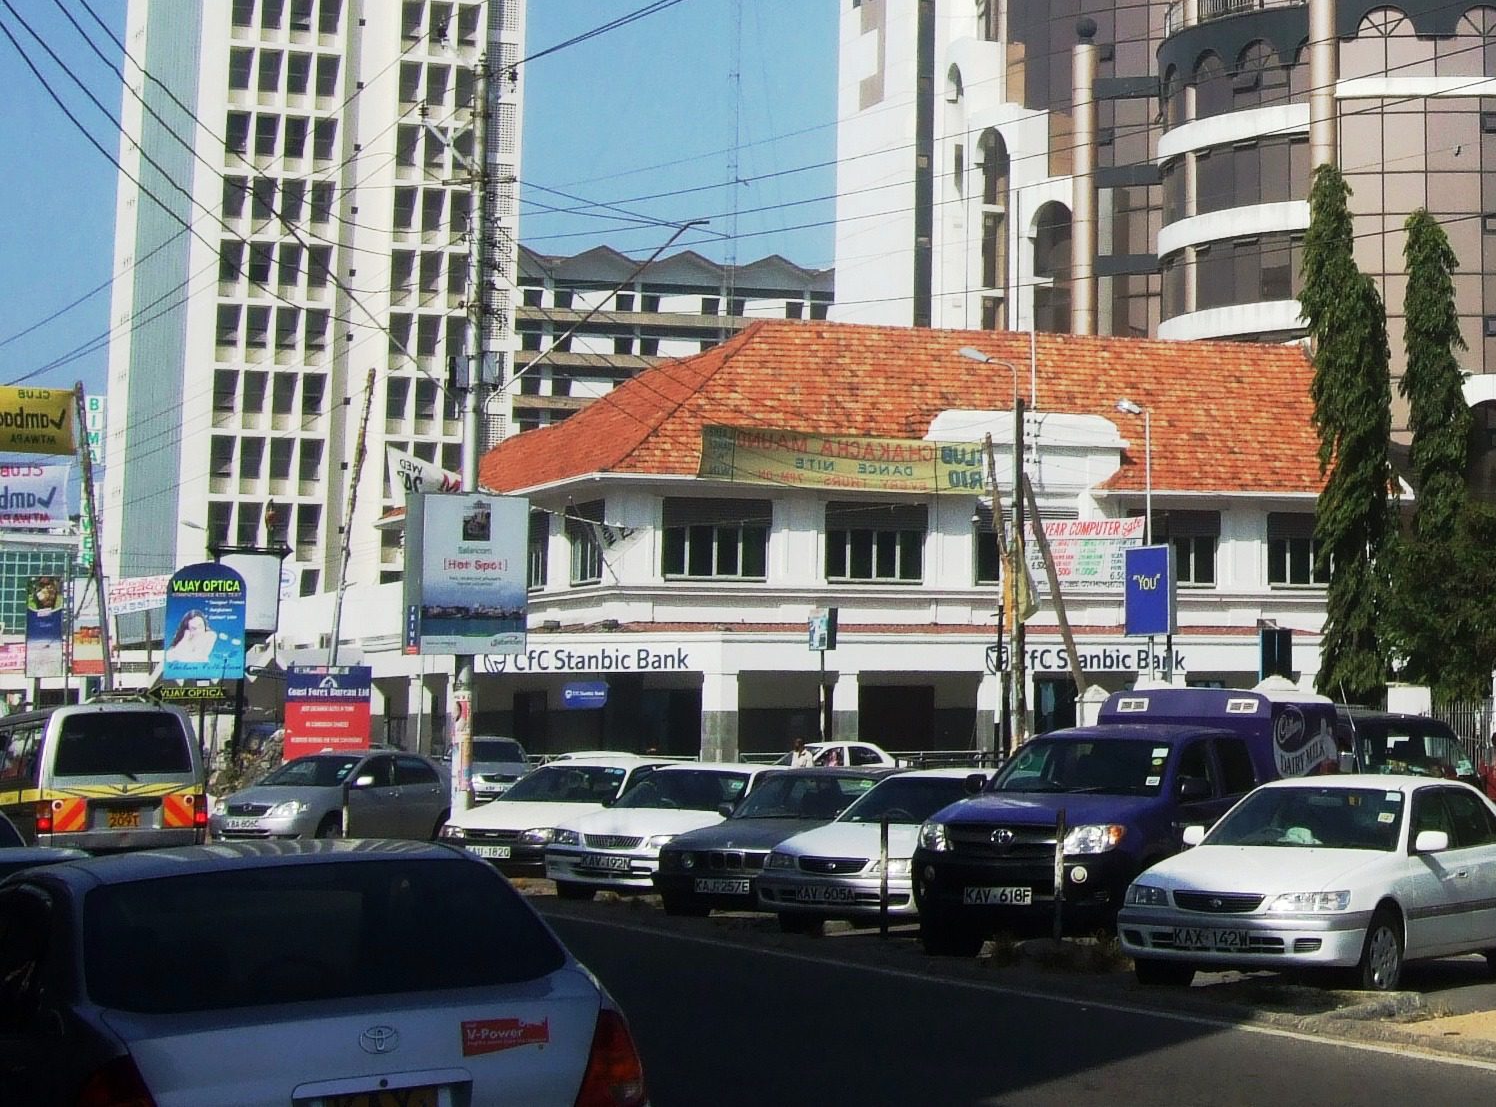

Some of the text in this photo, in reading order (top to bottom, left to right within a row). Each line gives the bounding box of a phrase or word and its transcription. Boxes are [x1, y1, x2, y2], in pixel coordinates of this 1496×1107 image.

[1070, 521, 1121, 536] COMPUTER
[172, 579, 241, 592] VIJAY OPTICA
[514, 647, 689, 671] CfC Stanbic Bank
[1056, 648, 1132, 670] Sanbic
[160, 689, 224, 698] VIJAY OPTICA
[1280, 753, 1305, 776] DAIRY
[998, 887, 1031, 904] 618F
[1173, 928, 1249, 947] KAX 142W
[466, 1028, 524, 1041] V-Power
